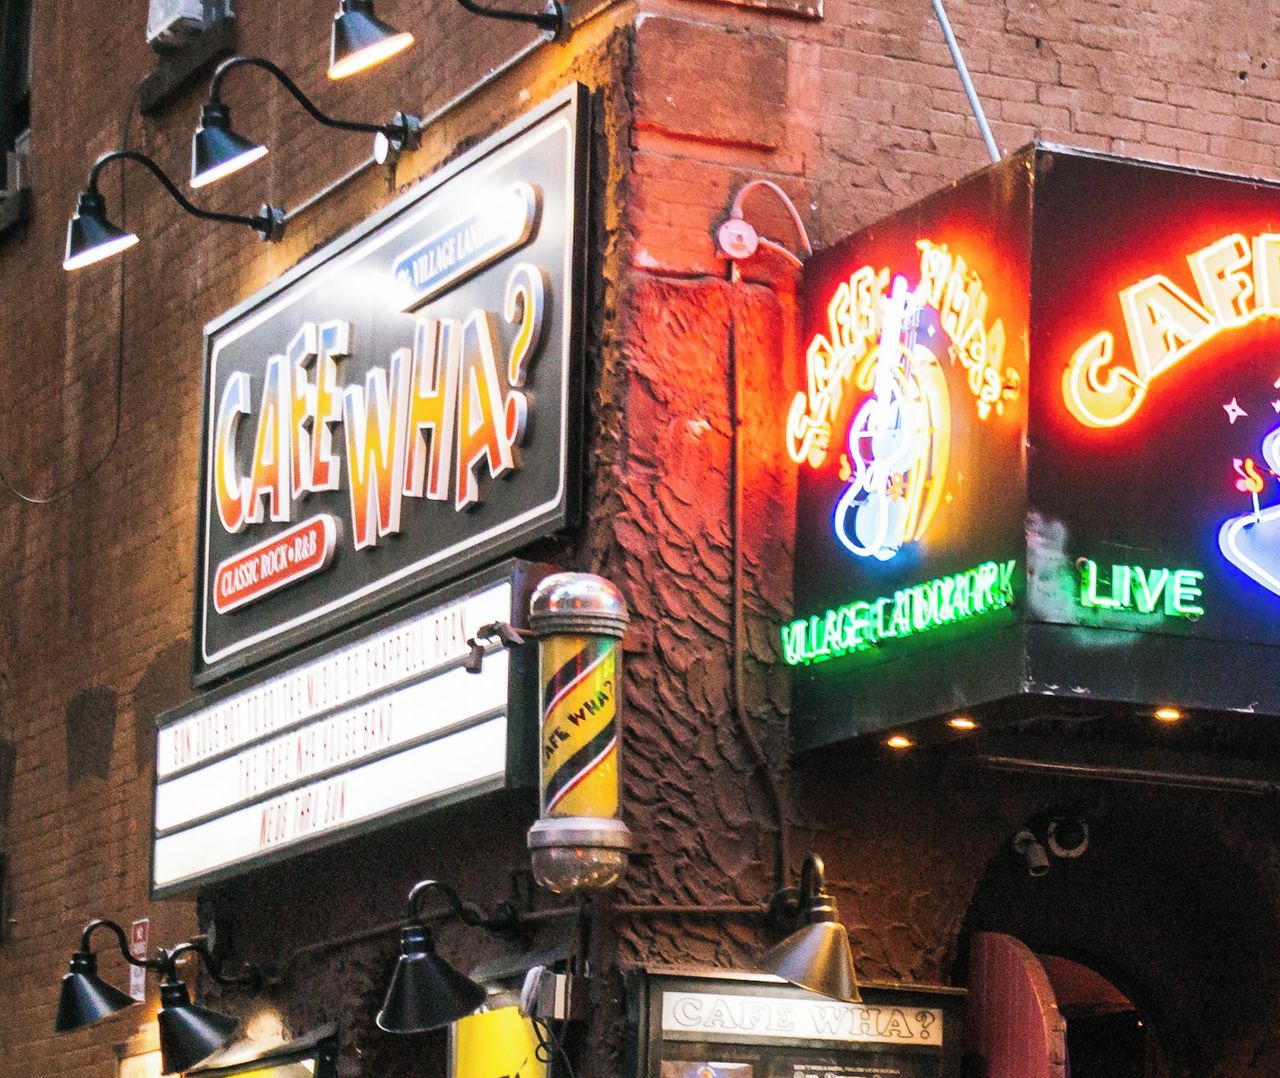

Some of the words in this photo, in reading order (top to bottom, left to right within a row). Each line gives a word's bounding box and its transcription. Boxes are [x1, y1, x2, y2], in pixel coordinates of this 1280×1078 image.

[413, 238, 456, 286] VILLAGE
[787, 265, 891, 468] CAFE
[216, 319, 352, 535] CAFE
[343, 263, 545, 551] WHA?
[221, 558, 260, 598] CLASSIC
[260, 546, 288, 584] ROCK
[293, 536, 317, 567] R&B
[1080, 559, 1205, 618] LIVE
[782, 600, 879, 665] VILLAGE
[545, 725, 571, 761] AFE
[569, 680, 615, 723] WHA?
[672, 997, 795, 1032] CAFE
[807, 1004, 936, 1041] WHA?
